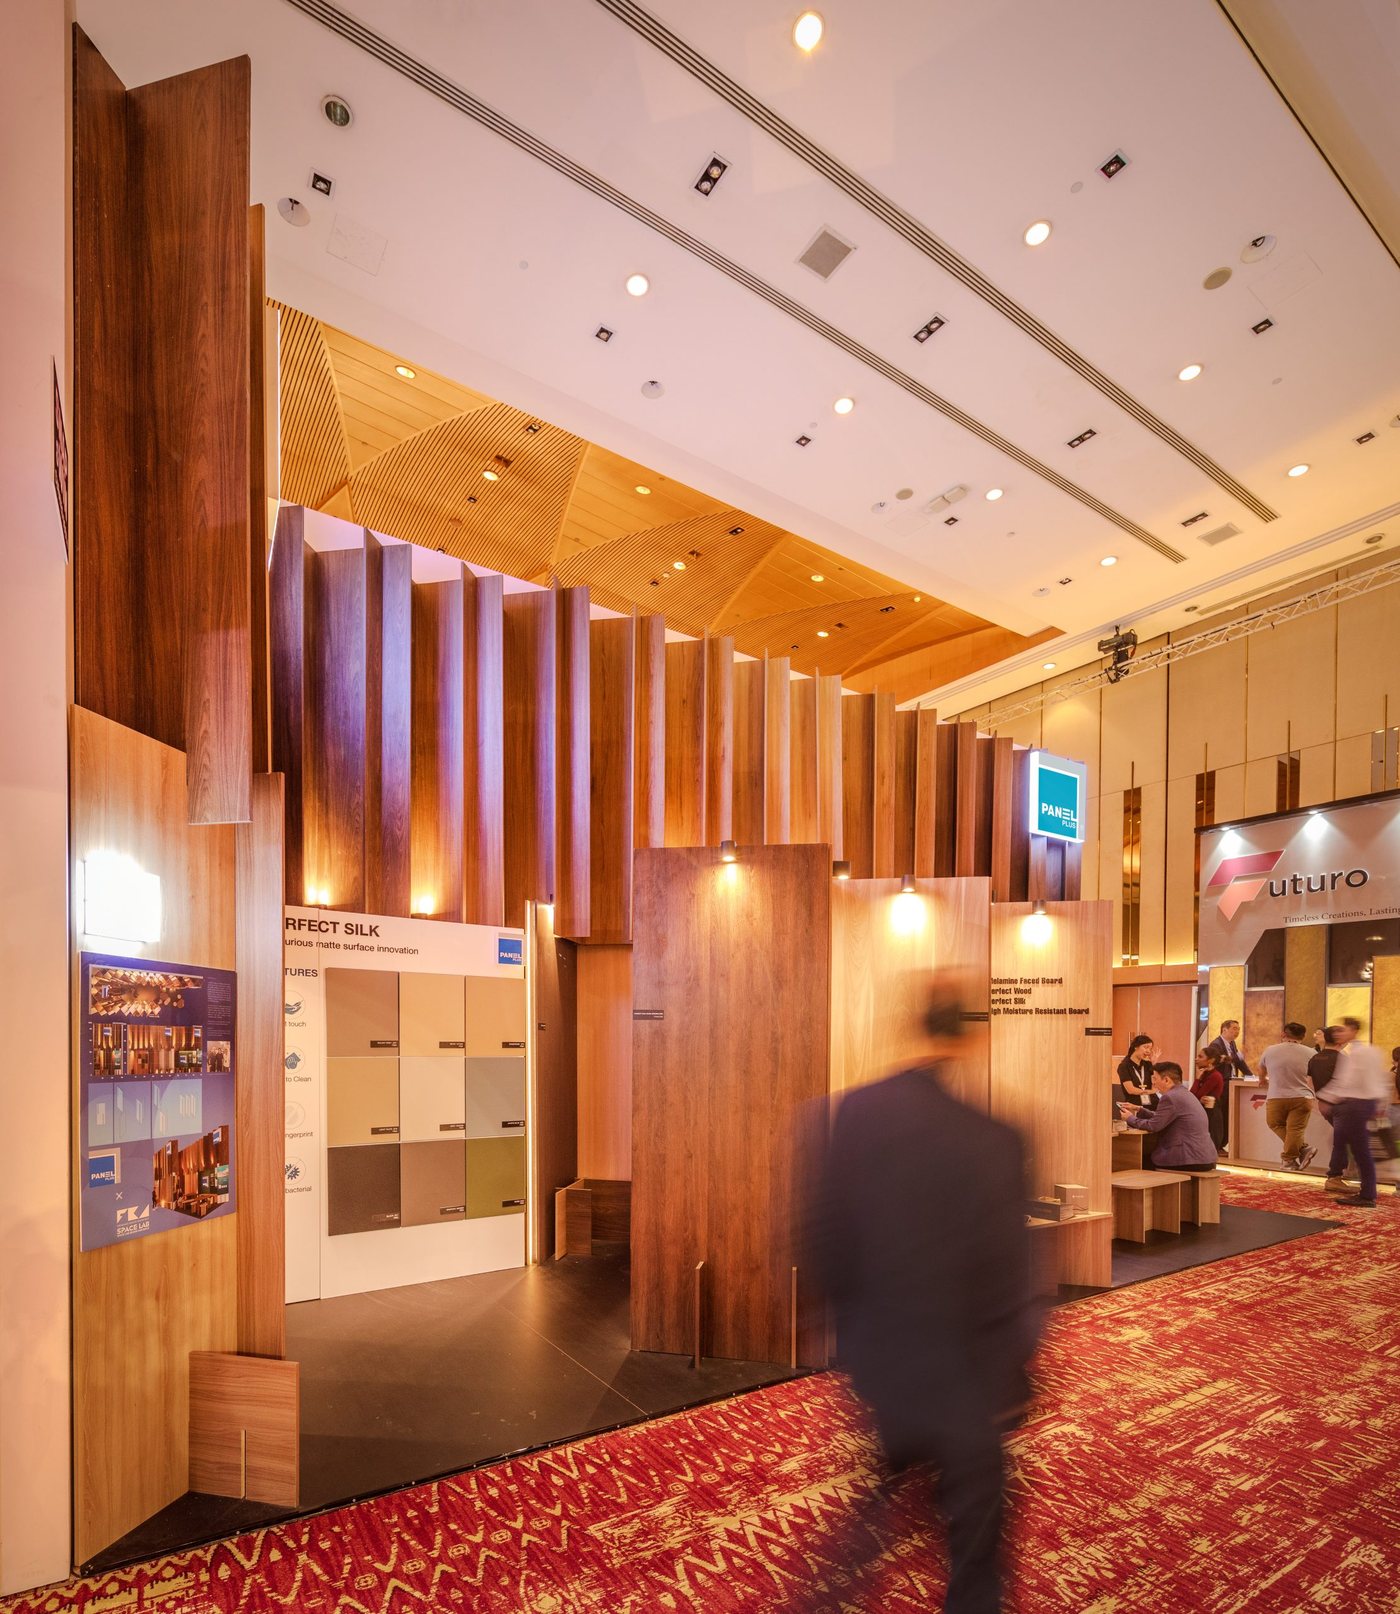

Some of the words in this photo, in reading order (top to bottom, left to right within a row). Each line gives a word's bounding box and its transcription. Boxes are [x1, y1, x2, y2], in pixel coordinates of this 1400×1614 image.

[1041, 802, 1077, 821] PANEL
[1061, 820, 1076, 829] PLUS
[1283, 914, 1319, 923] Timeless
[1321, 909, 1367, 919] Creations,
[344, 922, 380, 937] SILK
[316, 941, 341, 950] matte
[343, 943, 375, 952] surface
[377, 945, 419, 955] innovation
[499, 951, 522, 960] PANEL
[991, 977, 1019, 985] elamine
[1020, 977, 1040, 985] Faced
[1041, 977, 1063, 985] Board
[1014, 987, 1032, 995] Wood
[1014, 997, 1026, 1005] Silk
[1003, 1007, 1034, 1015] Moisture
[1035, 1007, 1067, 1015] Resistant
[1069, 1007, 1089, 1015] Board
[91, 1170, 116, 1181] PANEL
[116, 1223, 138, 1235] SPACE
[138, 1220, 150, 1230] LAB
